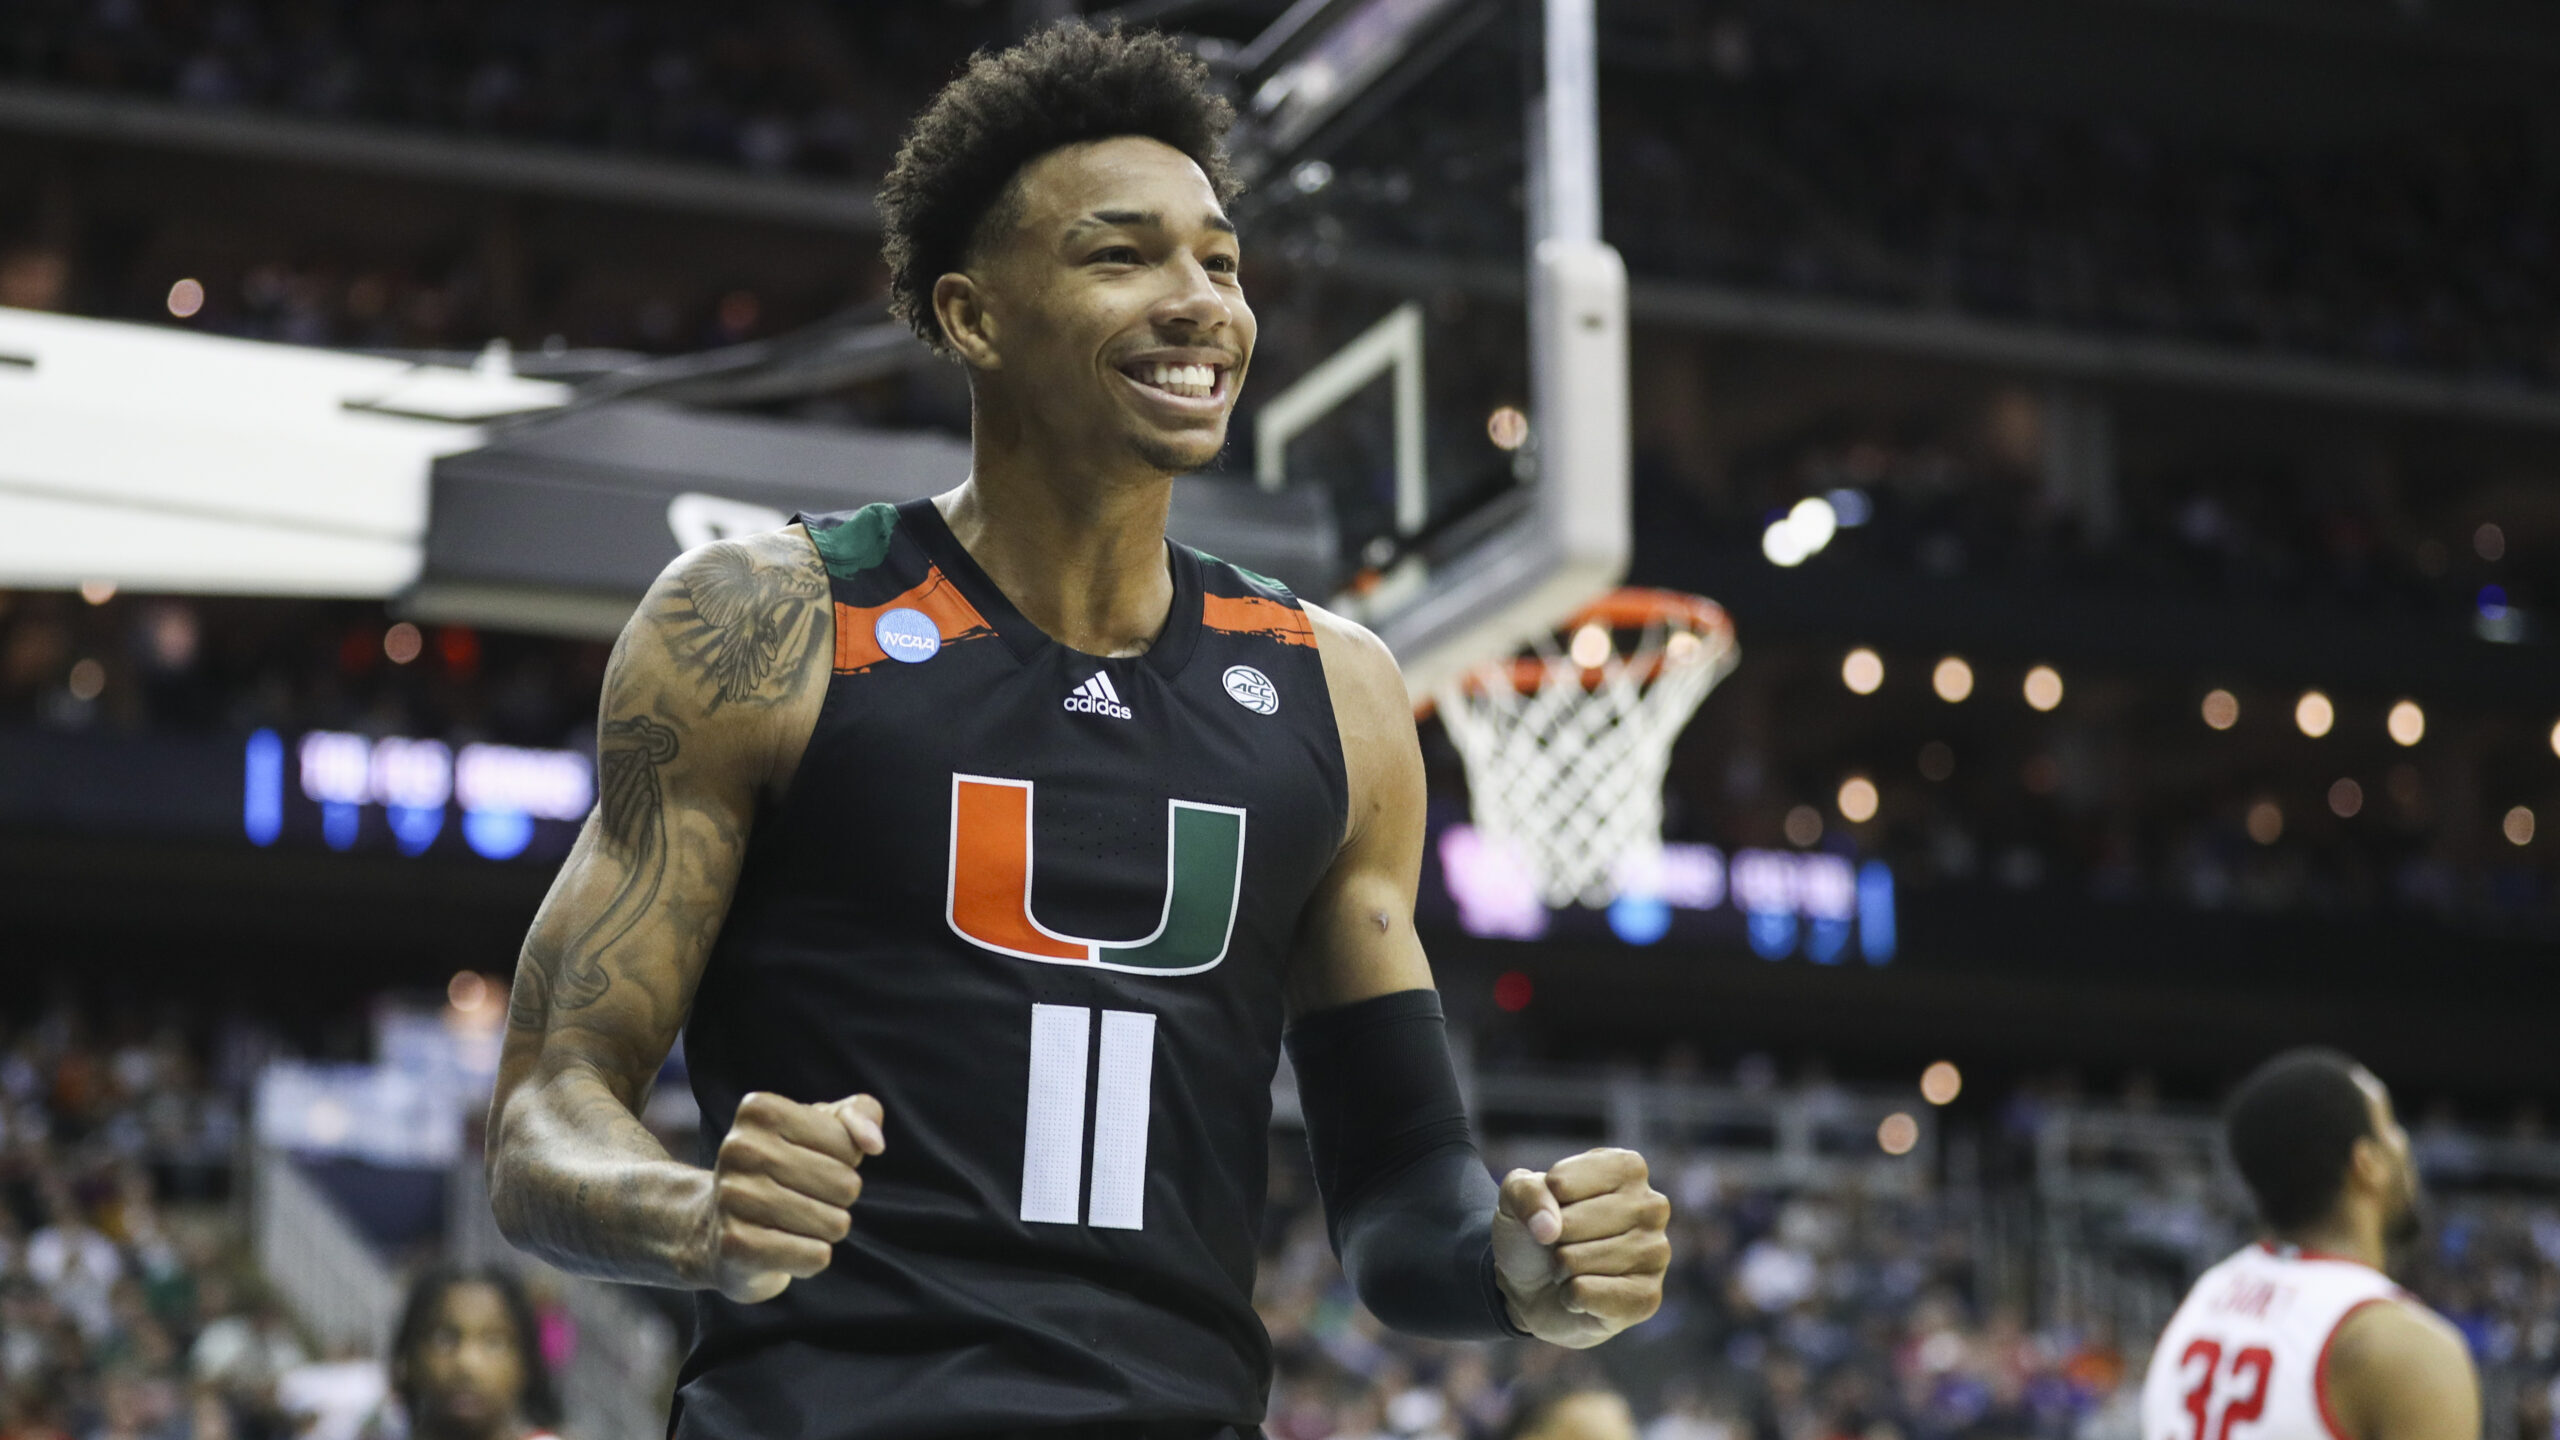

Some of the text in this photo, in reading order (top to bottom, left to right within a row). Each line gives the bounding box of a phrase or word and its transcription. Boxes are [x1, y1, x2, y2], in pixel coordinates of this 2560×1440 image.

[884, 631, 936, 652] NCAA
[1063, 695, 1132, 720] adidas
[1232, 683, 1272, 699] ACC
[946, 773, 1247, 976] U
[1020, 1003, 1157, 1231] 11
[2172, 1338, 2274, 1440] 32
